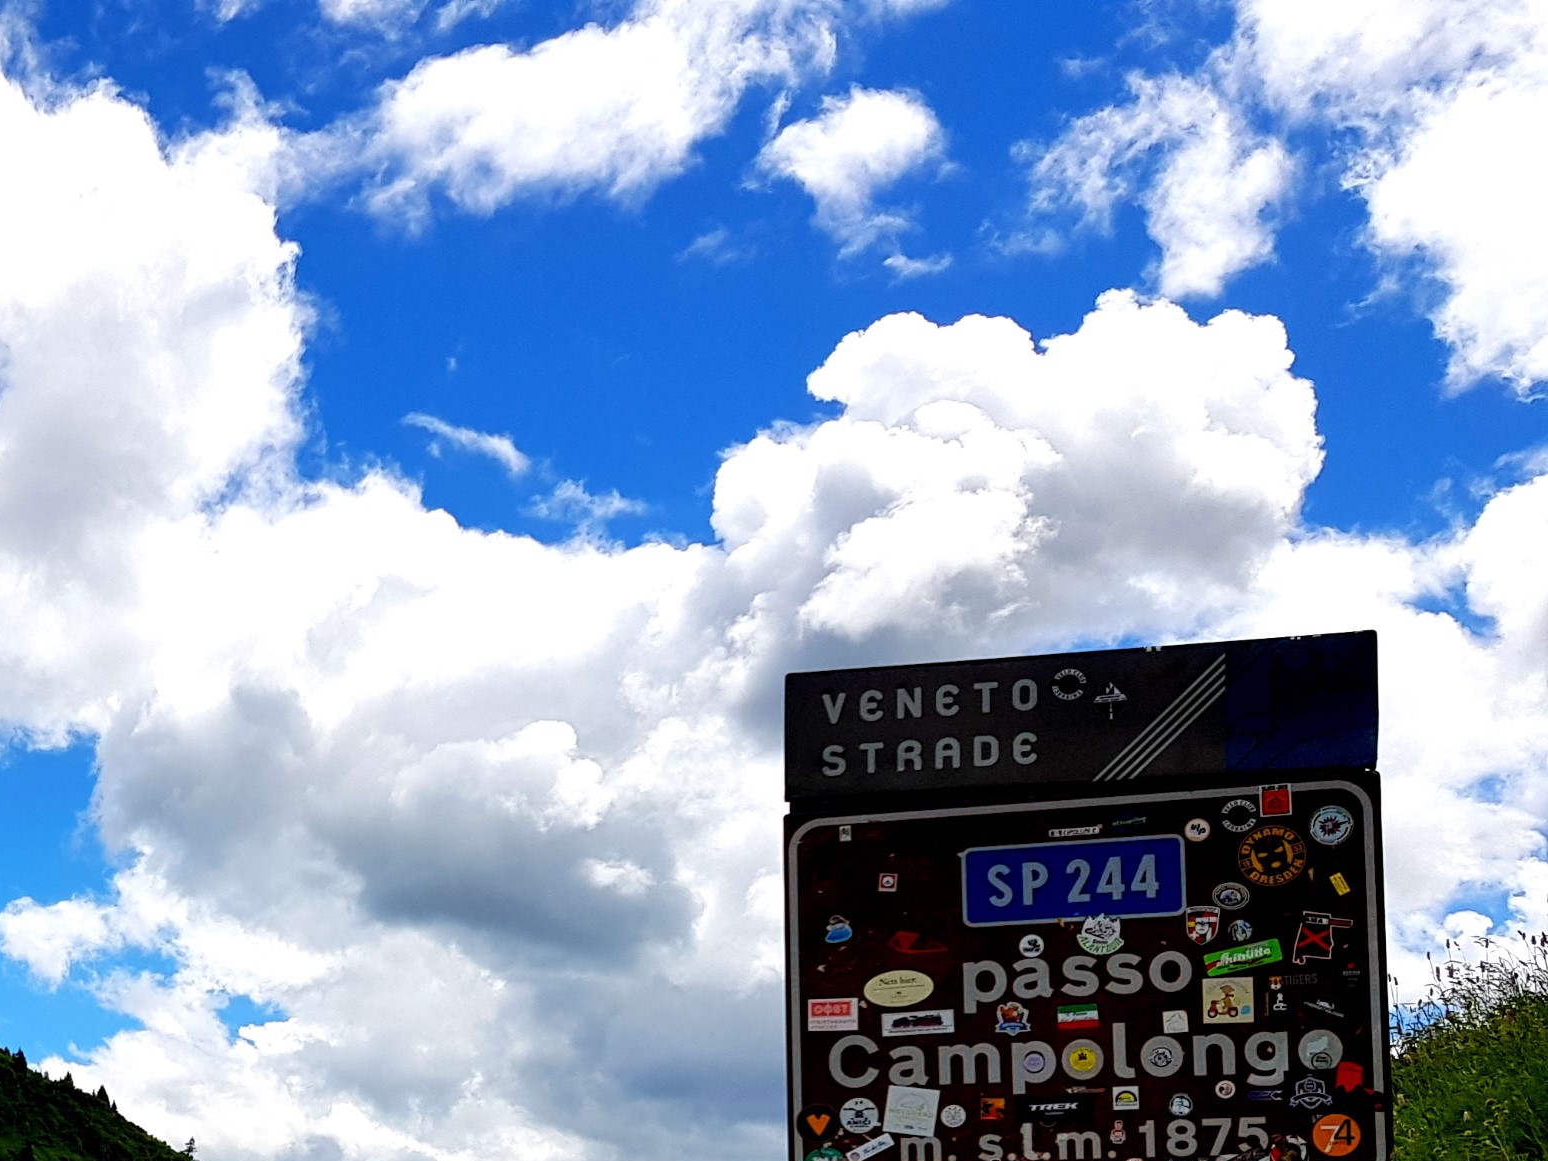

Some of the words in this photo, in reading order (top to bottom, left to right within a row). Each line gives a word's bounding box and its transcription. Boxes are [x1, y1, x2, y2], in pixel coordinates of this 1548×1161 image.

[822, 678, 1039, 725] VENETO
[821, 731, 1039, 778] STRADE
[1240, 827, 1295, 855] DYNAMO
[988, 862, 1048, 908] SP
[1065, 853, 1160, 904] 244
[1249, 859, 1304, 886] DRESDEN
[963, 951, 1192, 1013] passo
[1284, 973, 1319, 988] TIGERS
[829, 1022, 1344, 1095] Campolongo
[1028, 1101, 1081, 1112] TREK
[1138, 1116, 1269, 1159] 1875
